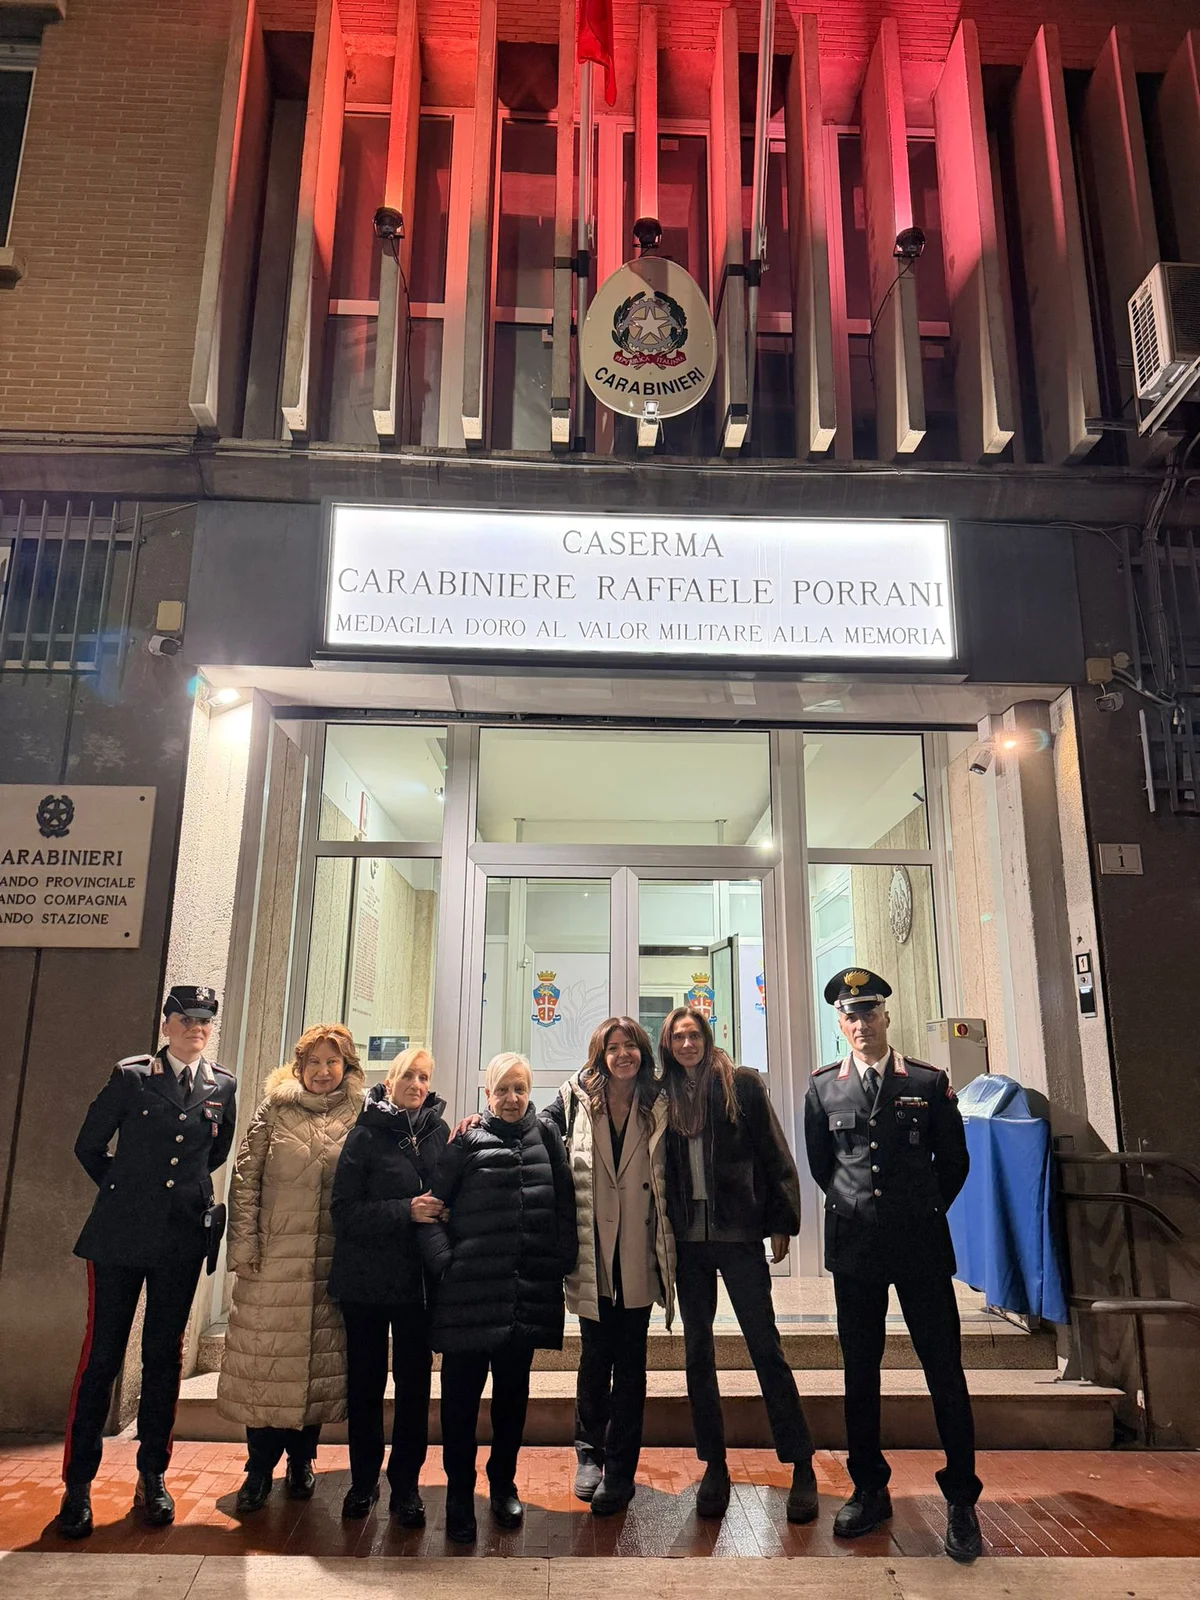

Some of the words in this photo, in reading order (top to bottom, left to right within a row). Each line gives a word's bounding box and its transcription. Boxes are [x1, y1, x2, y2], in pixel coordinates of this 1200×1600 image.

[595, 367, 705, 395] CARABINIERI
[563, 530, 724, 557] CASERMA
[338, 568, 577, 599] CARABINIERE
[597, 575, 774, 603] RAFFAELE
[792, 579, 944, 607] PORRANI
[335, 613, 454, 635] MEDAGLIA
[465, 618, 527, 637] D'ORO
[536, 620, 567, 638] AL
[578, 621, 650, 640] VALOR
[659, 623, 764, 643] MILITARE
[773, 625, 834, 644] ALLA
[845, 626, 946, 646] MEMORIA
[1, 849, 123, 866] ARABINIERI
[1118, 855, 1125, 868] 1
[0, 876, 39, 888] ANDO
[45, 876, 136, 889] PROVINCIALE
[0, 893, 37, 906] ANDO
[43, 894, 128, 907] COMPAGNIA
[41, 913, 110, 925] STAZIONE
